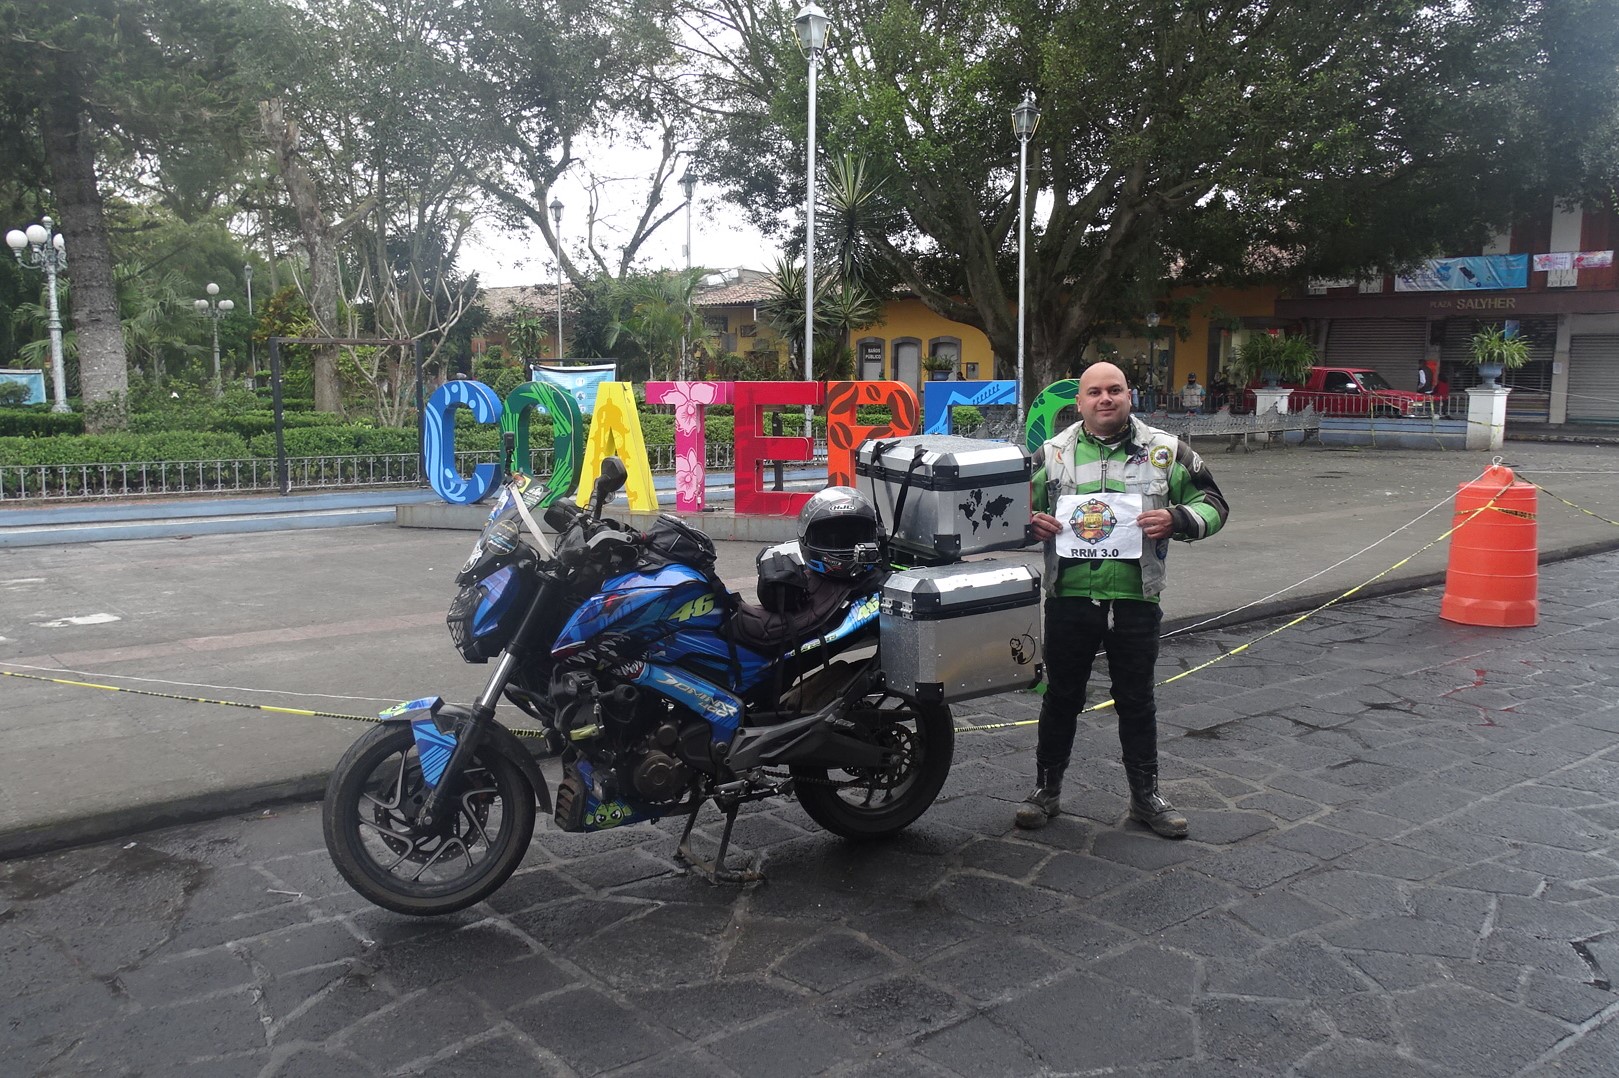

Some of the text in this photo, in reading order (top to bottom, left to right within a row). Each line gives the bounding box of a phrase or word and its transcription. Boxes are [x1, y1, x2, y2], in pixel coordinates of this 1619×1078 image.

[1456, 297, 1516, 310] SALYHER
[1070, 548, 1119, 558] RRM 3.0
[667, 593, 716, 622] 46
[857, 597, 880, 621] 46
[698, 702, 728, 717] 400
